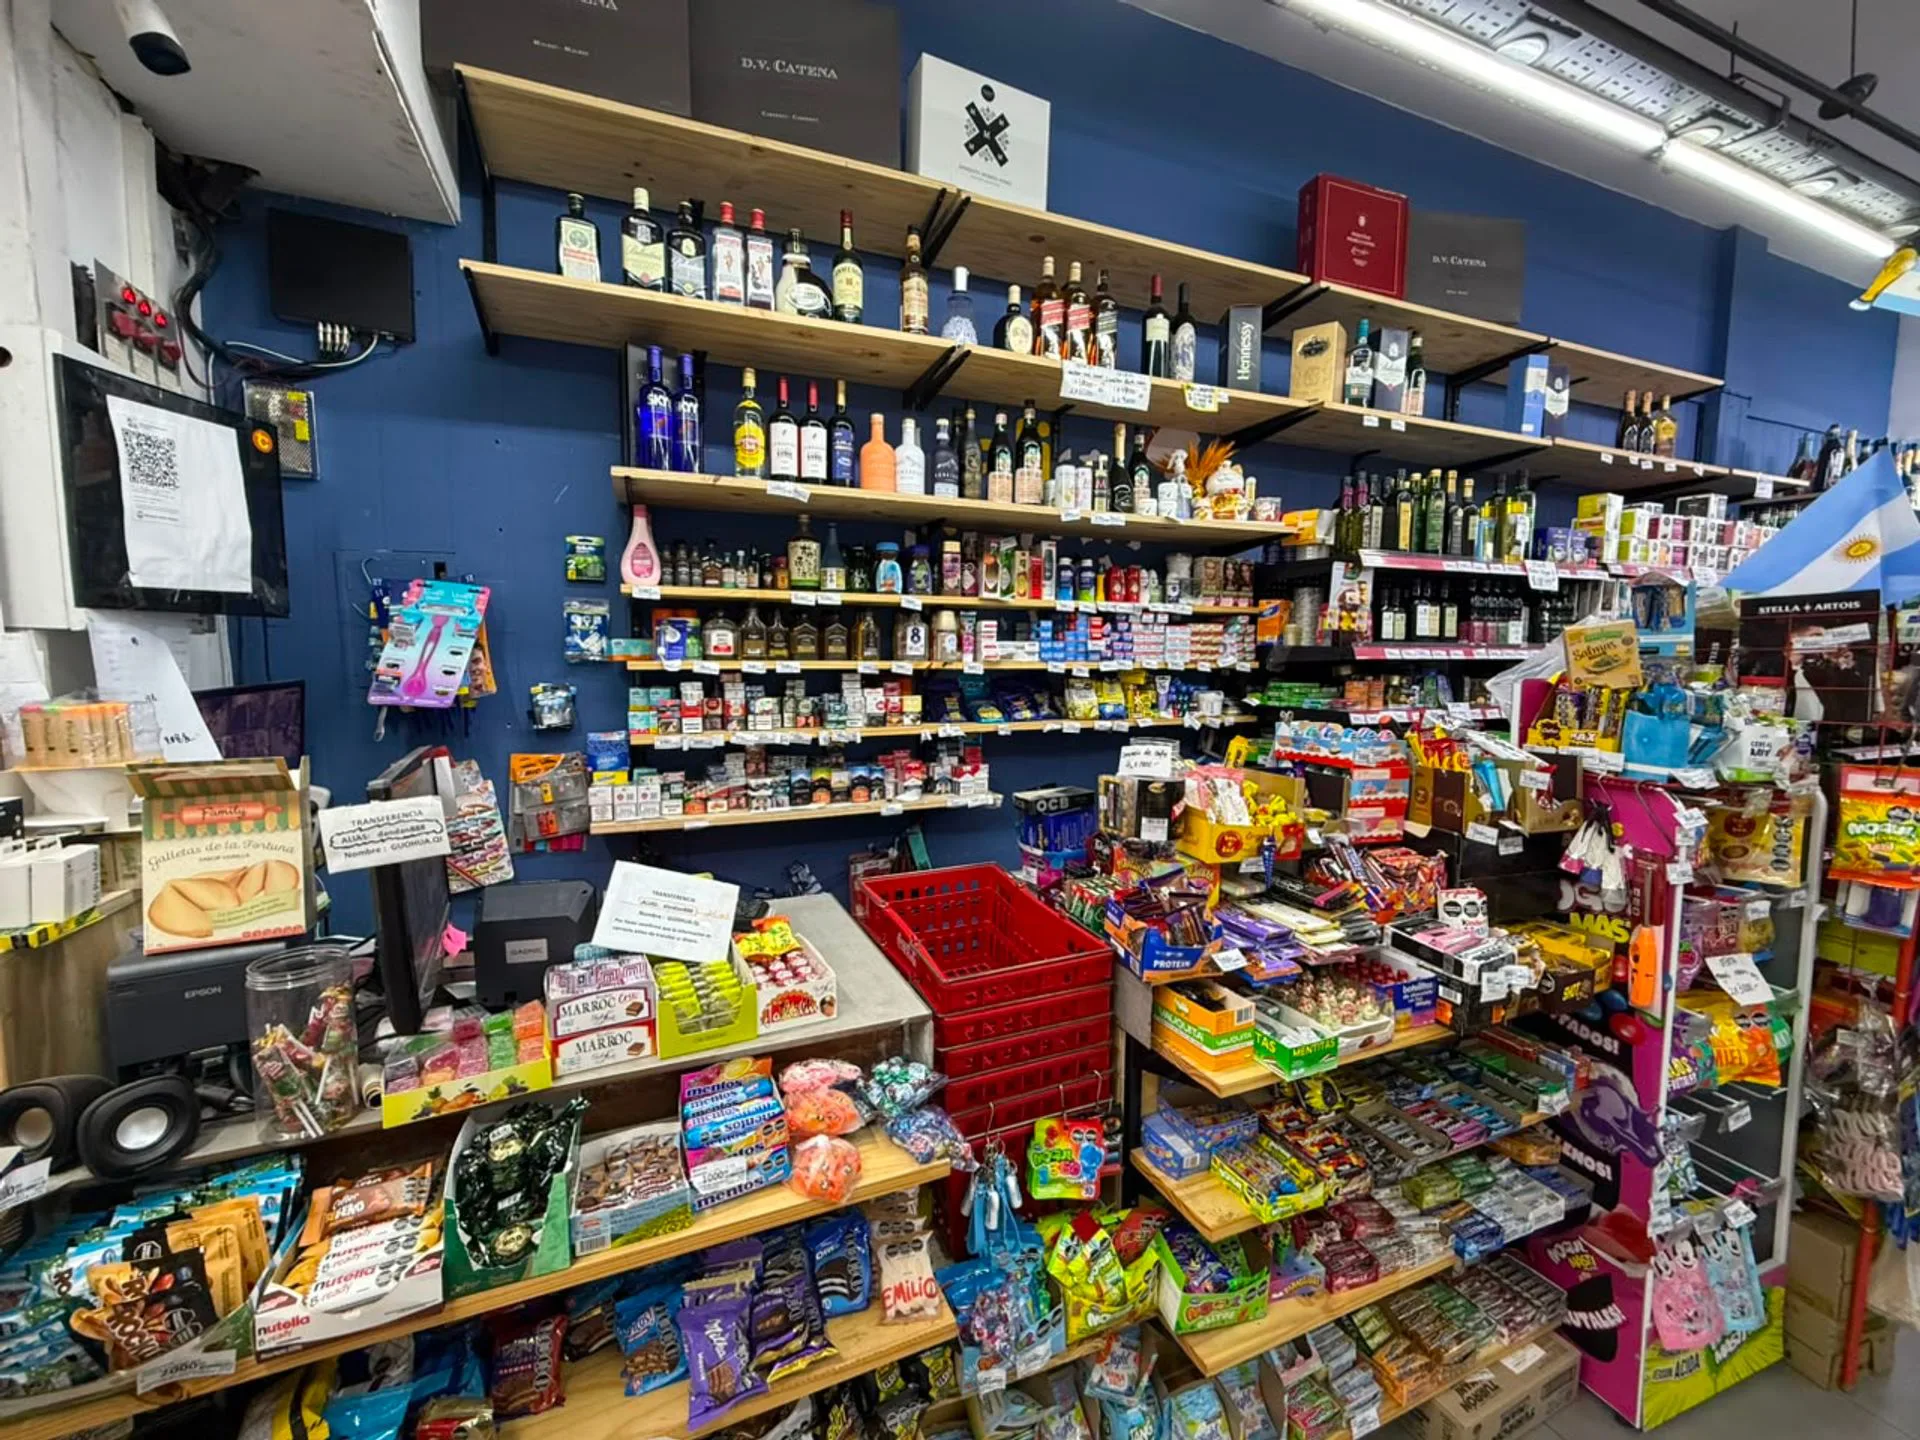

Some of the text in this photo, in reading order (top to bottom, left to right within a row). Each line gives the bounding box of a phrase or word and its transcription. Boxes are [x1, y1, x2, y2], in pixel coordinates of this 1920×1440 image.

[741, 57, 839, 80] D.V. CATENA
[1432, 254, 1487, 269] D.V. CATENA
[1236, 320, 1256, 382] Hennessy
[1758, 601, 1861, 615] STELLA ARTOIS
[910, 626, 922, 644] 8
[202, 805, 248, 821] Family
[1036, 797, 1070, 813] OCB
[351, 809, 425, 827] TRANSFERENCIA
[341, 832, 370, 845] ALIAS:
[148, 838, 296, 871] Galletas de la Fortuna
[344, 846, 381, 859] Nombre
[1153, 959, 1192, 969] PROTEIN
[183, 985, 222, 1000] EPSON
[561, 997, 617, 1017] MARROC
[575, 1030, 633, 1055] MARROC
[1292, 1037, 1336, 1057] MENTITAS
[686, 1079, 743, 1096] mentos
[690, 1091, 739, 1109] mentos
[692, 1108, 740, 1125] mentos
[696, 1176, 765, 1209] mentos
[313, 1264, 377, 1292] nutella
[258, 1314, 311, 1336] nutella
[704, 1318, 729, 1360] Milka
